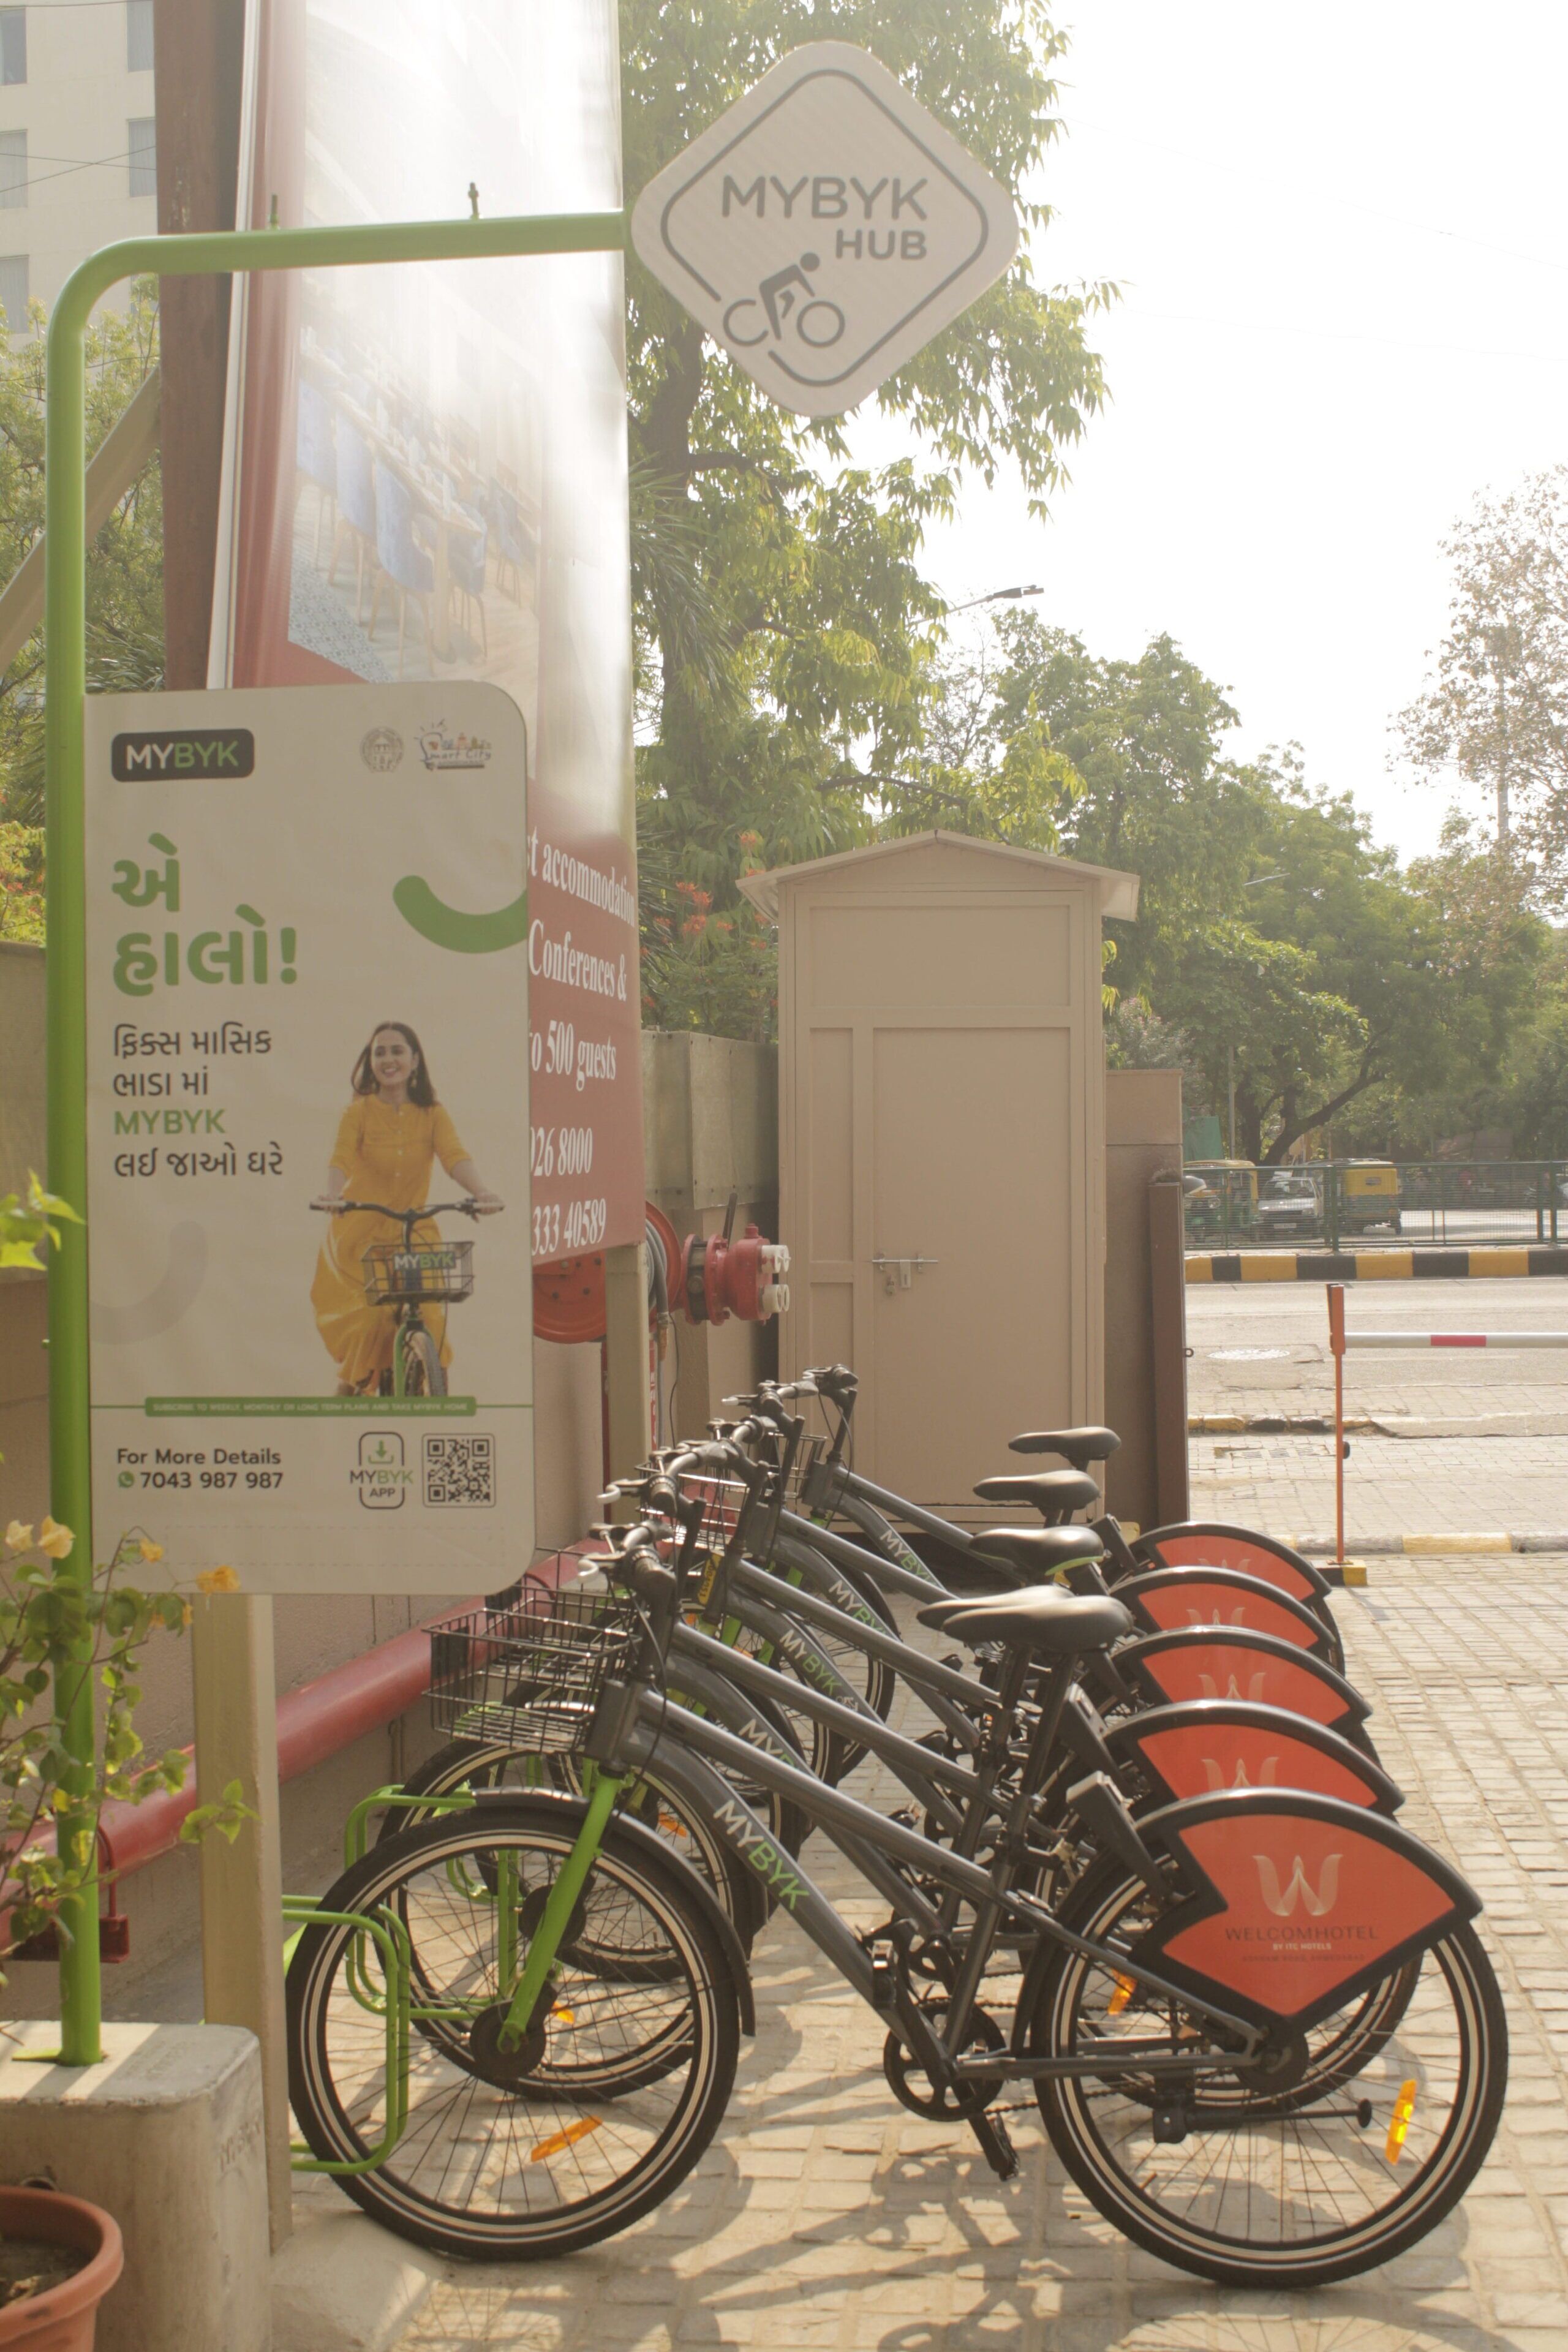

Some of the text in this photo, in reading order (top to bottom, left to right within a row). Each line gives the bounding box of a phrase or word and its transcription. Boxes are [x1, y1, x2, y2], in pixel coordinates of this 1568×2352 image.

[722, 175, 927, 220] MYBYK
[835, 229, 927, 260] HUB
[126, 742, 238, 770] MYBYK
[112, 832, 179, 912] એ
[541, 843, 635, 928] accommodation
[113, 903, 297, 997] હાલો!
[529, 919, 628, 1002] Conferences &
[115, 1021, 271, 1059] ફિક્સ માસિક
[546, 1019, 574, 1076] 500
[576, 1036, 616, 1091] guests
[113, 1066, 208, 1096] ભાડા માં
[115, 1109, 225, 1134] MYBYK
[115, 1141, 283, 1177] લઈ જાઓ ઘરે
[558, 1127, 593, 1176] 8000
[564, 1197, 606, 1249] 40589
[394, 1253, 453, 1270] MYBYK
[118, 1448, 281, 1464] For More Details
[141, 1472, 283, 1488] 7043 987 987
[350, 1470, 413, 1484] MYBYK
[369, 1488, 396, 1498] APP
[779, 1628, 843, 1696] MYBYK
[713, 1799, 810, 1910] MYBYK
[1225, 1925, 1379, 1941] WELCOMHOTEL
[1285, 1942, 1298, 1951] ITC
[1300, 1942, 1332, 1951] HOTELS
